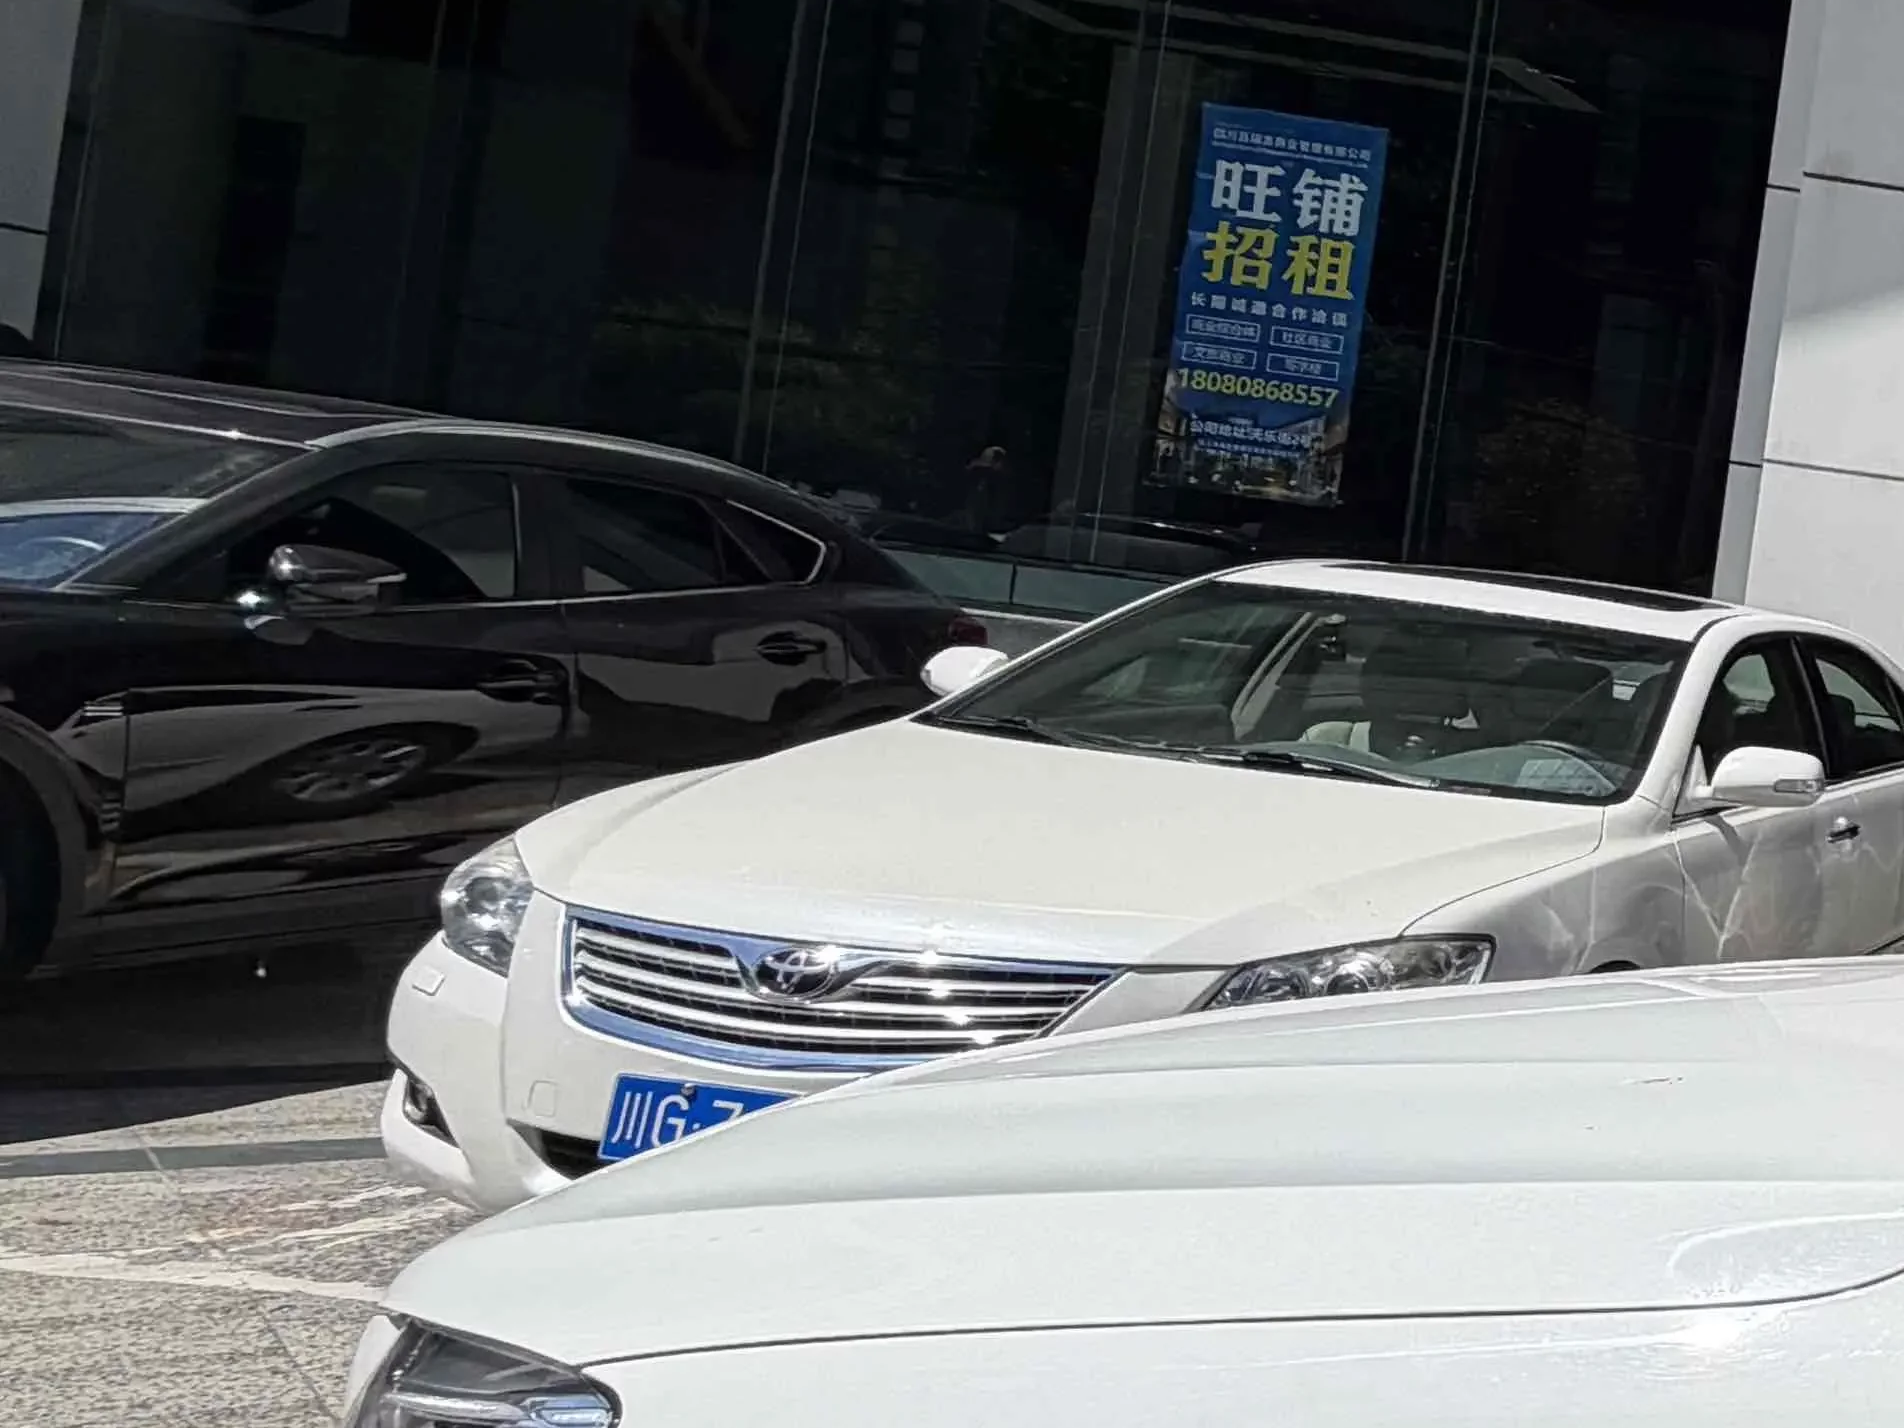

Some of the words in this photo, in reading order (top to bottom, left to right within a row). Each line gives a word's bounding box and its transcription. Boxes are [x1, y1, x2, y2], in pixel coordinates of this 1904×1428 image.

[1210, 159, 1369, 236] 旺铺
[1202, 220, 1354, 300] 招租
[1177, 368, 1338, 409] 18080868557
